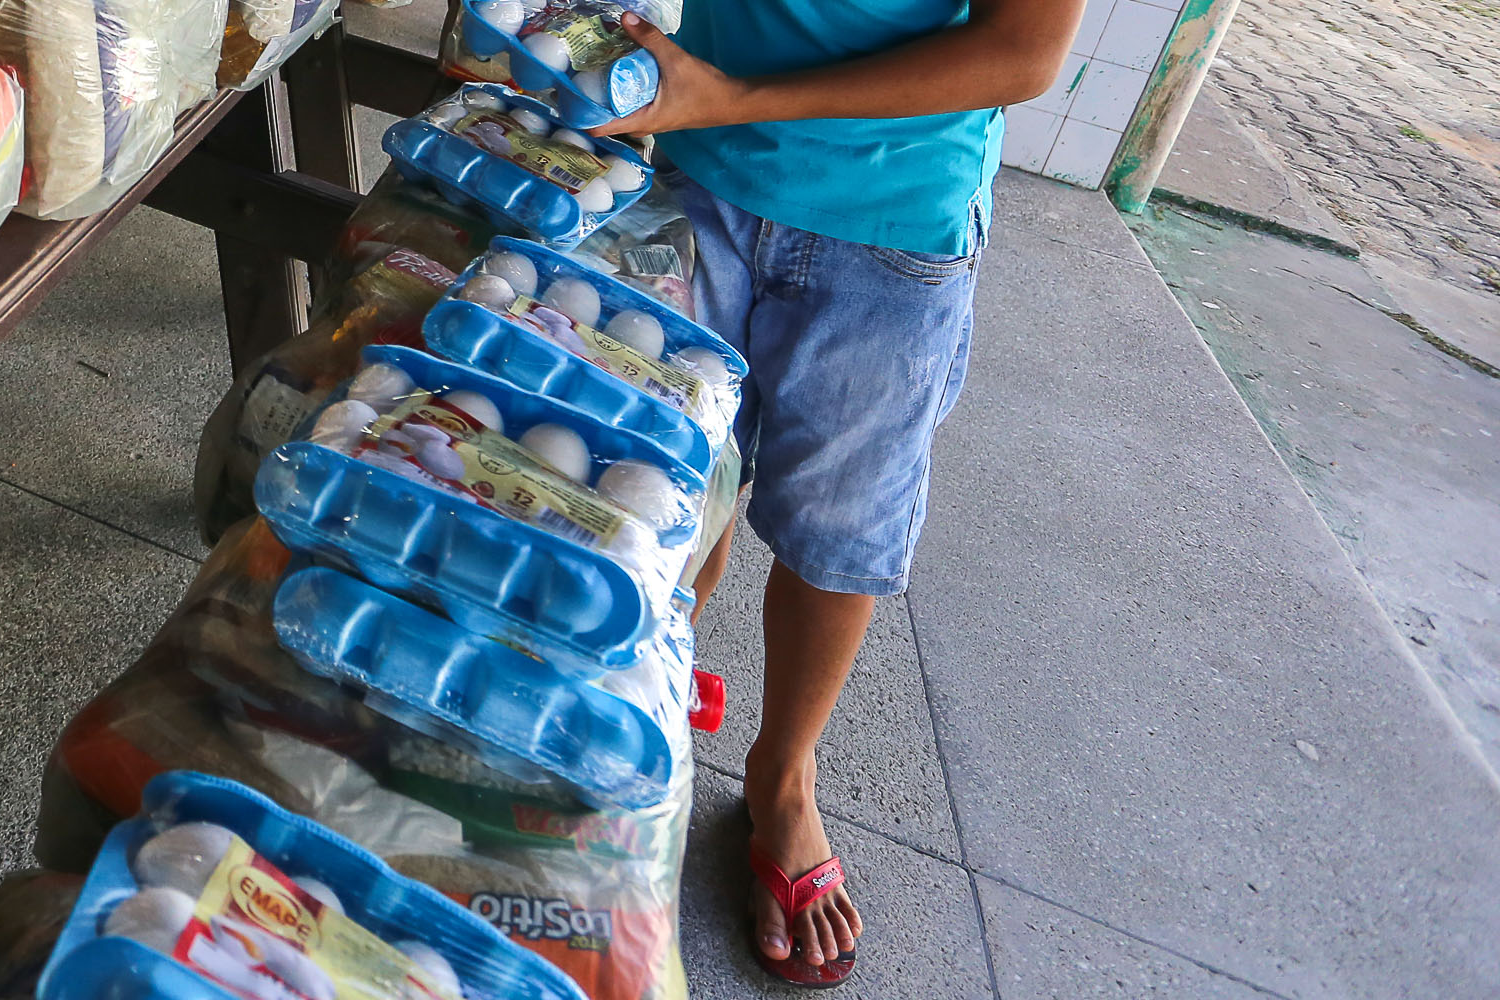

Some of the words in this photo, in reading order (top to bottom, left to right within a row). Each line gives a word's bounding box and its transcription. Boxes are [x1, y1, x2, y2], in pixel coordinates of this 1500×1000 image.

[536, 155, 551, 166] 12
[622, 364, 639, 377] 12
[513, 492, 534, 509] 12
[240, 876, 312, 940] EMAPE
